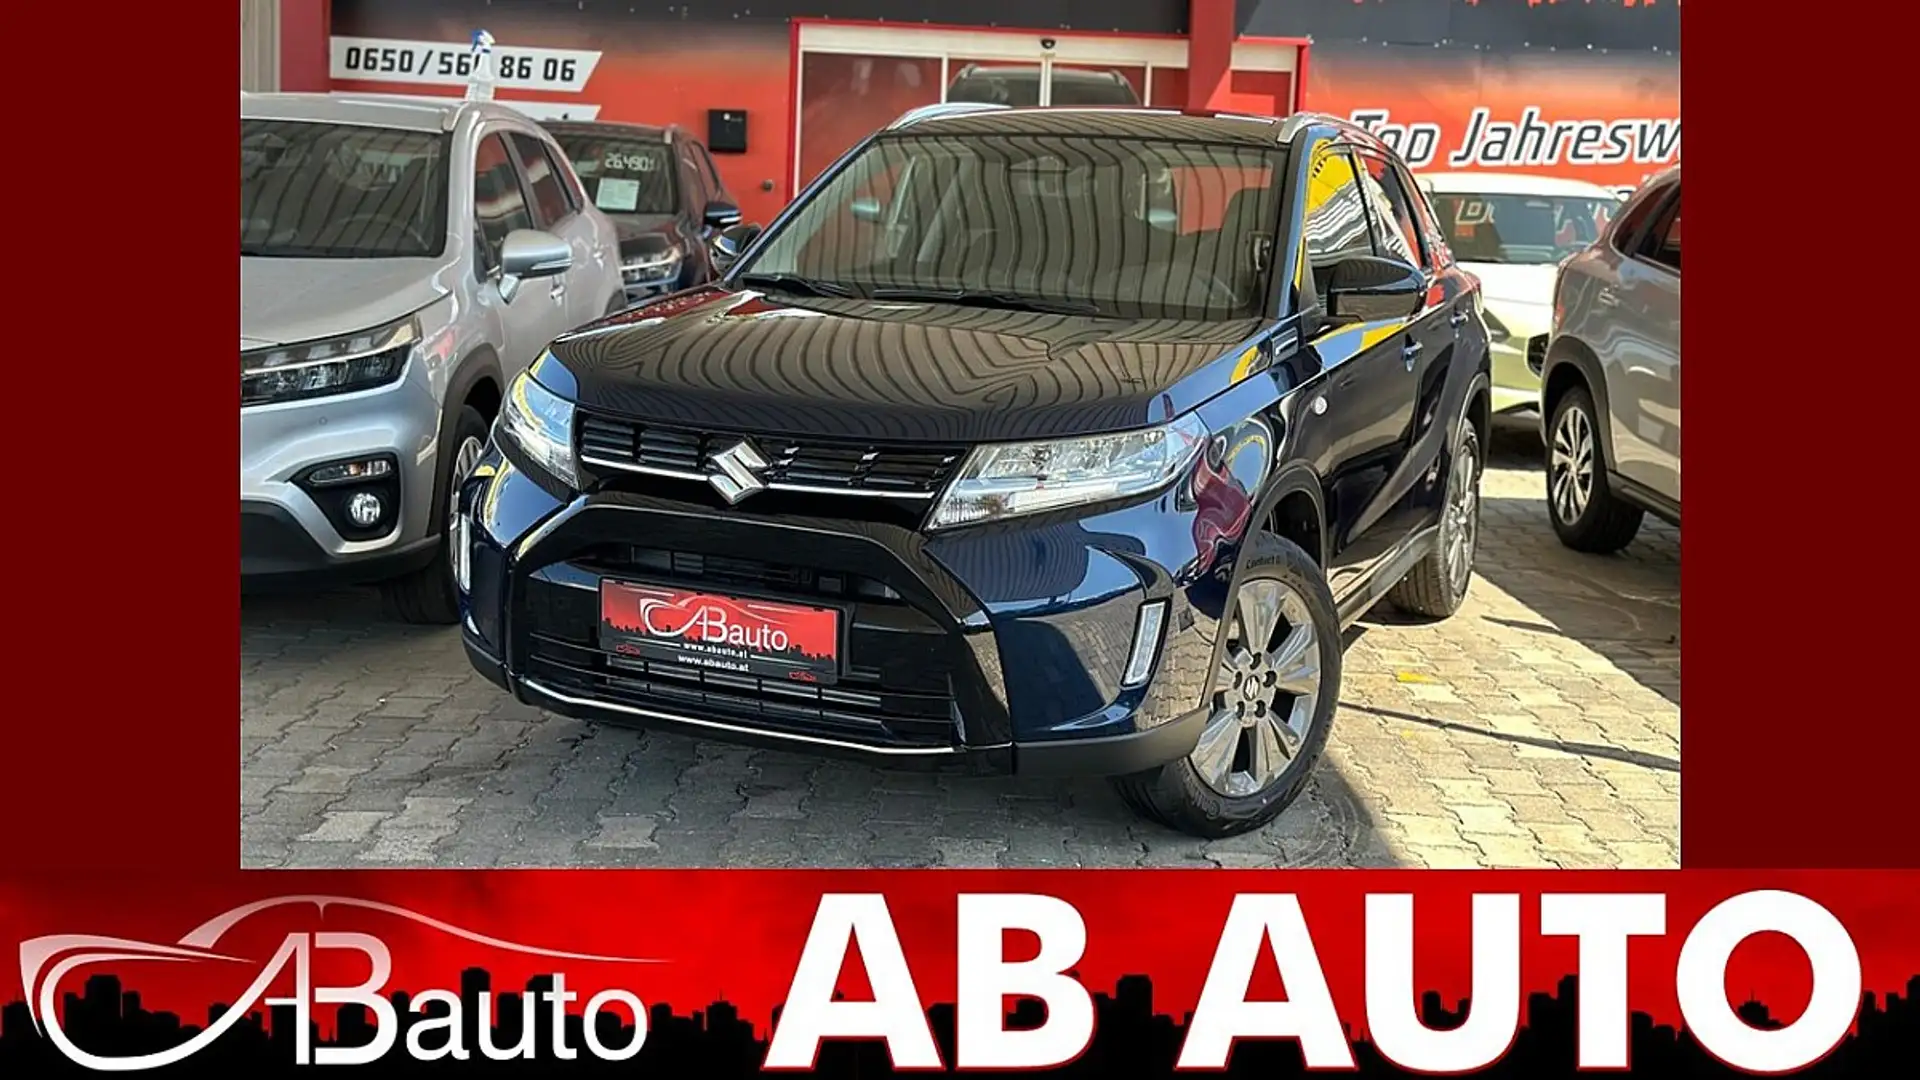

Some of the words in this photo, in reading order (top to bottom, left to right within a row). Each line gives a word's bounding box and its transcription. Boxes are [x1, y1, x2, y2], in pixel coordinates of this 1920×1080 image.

[500, 56, 532, 79] 86
[543, 58, 576, 82] 06
[677, 654, 749, 673] www.abauto.at
